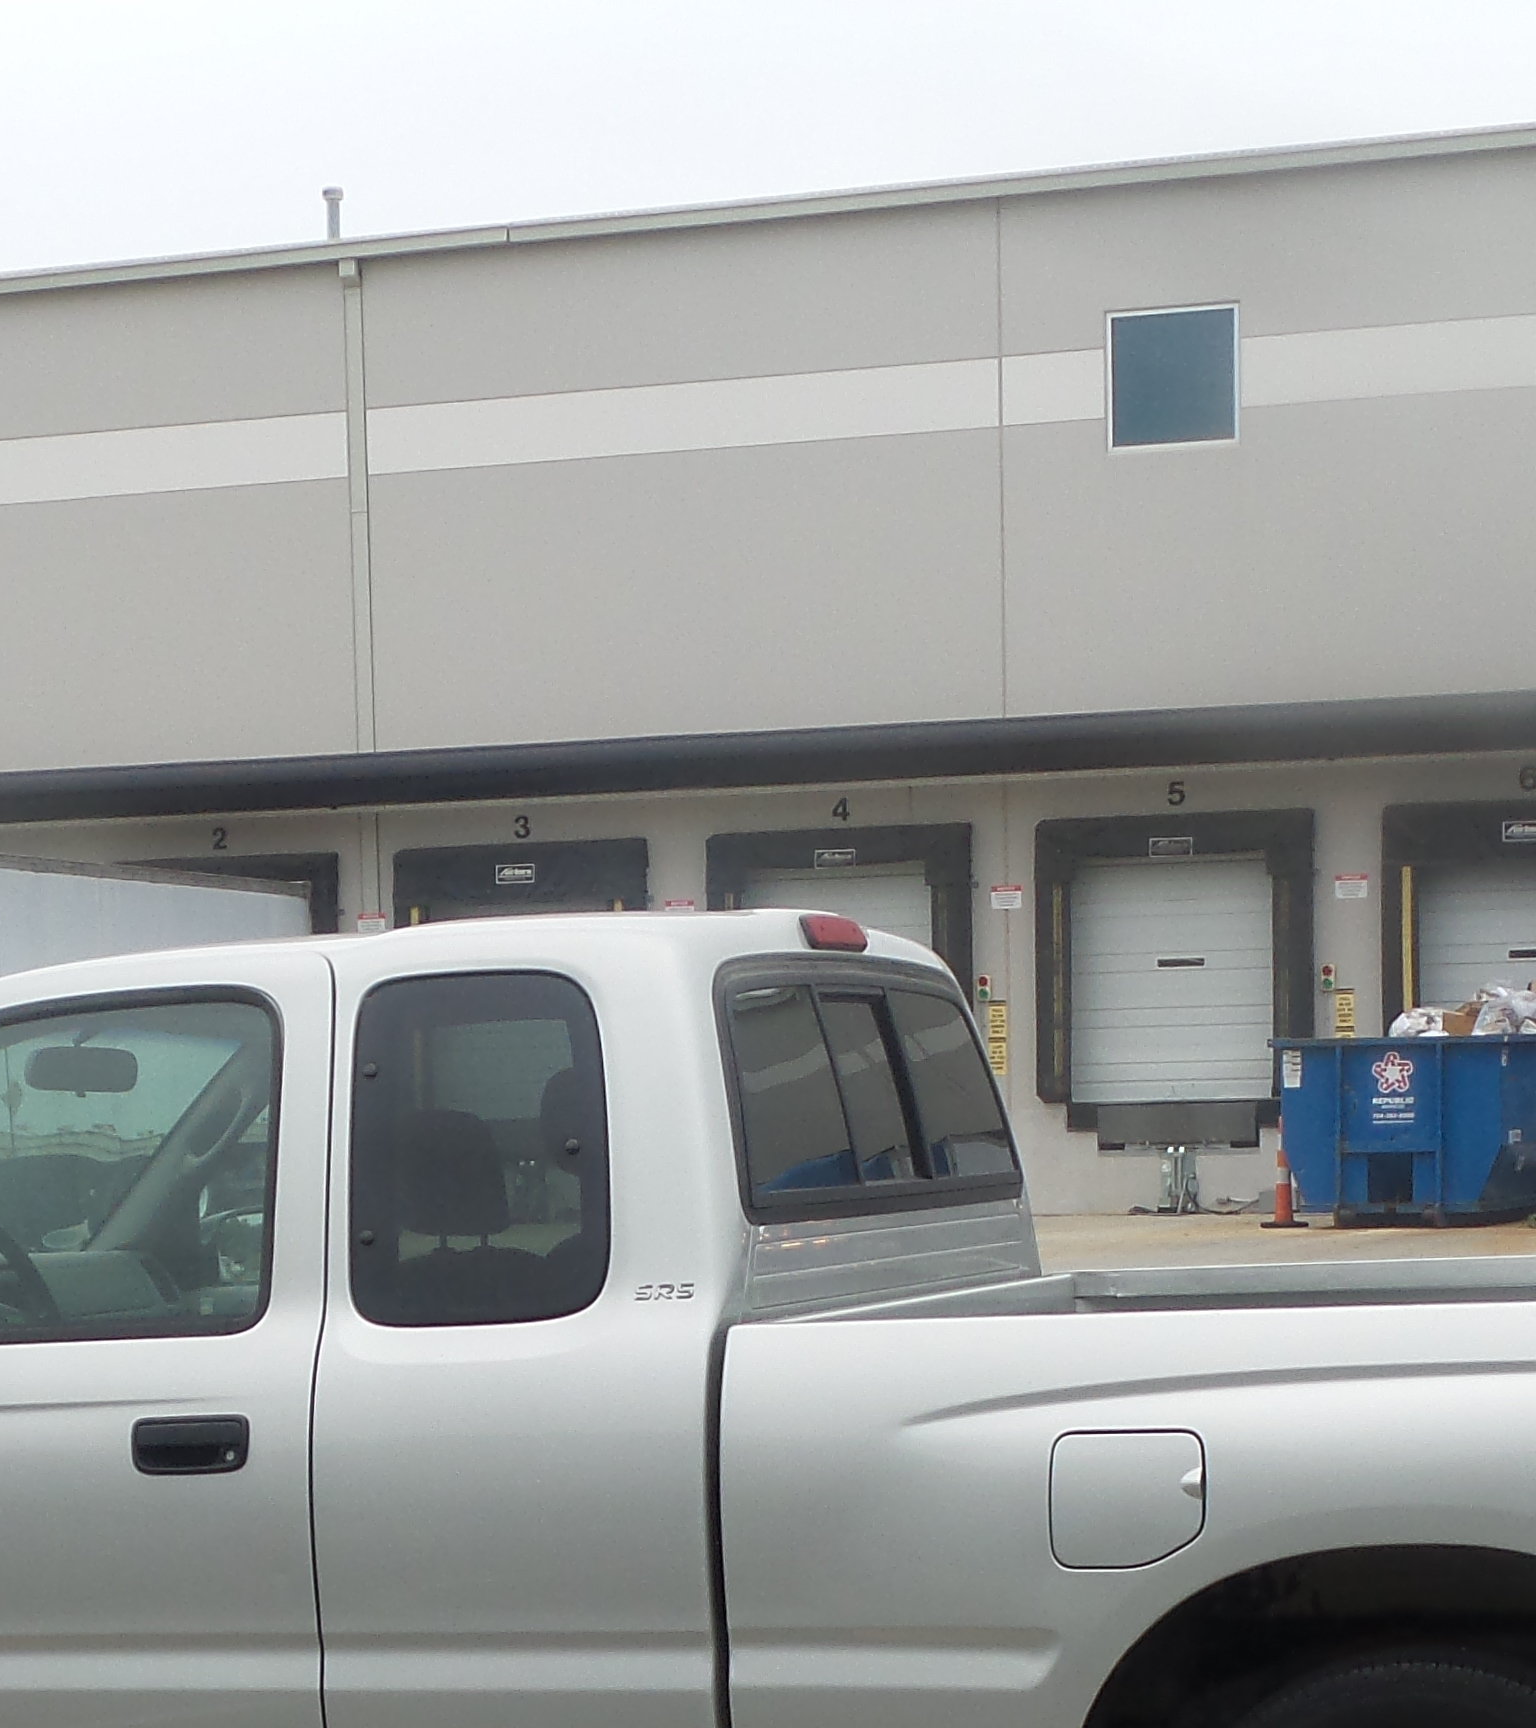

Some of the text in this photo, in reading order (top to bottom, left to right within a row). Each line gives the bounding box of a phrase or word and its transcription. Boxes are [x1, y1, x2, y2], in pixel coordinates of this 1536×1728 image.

[1167, 780, 1186, 807] 5
[831, 796, 851, 822] 4
[212, 827, 228, 850] 2
[514, 814, 531, 839] 3
[634, 1282, 695, 1302] SR5
